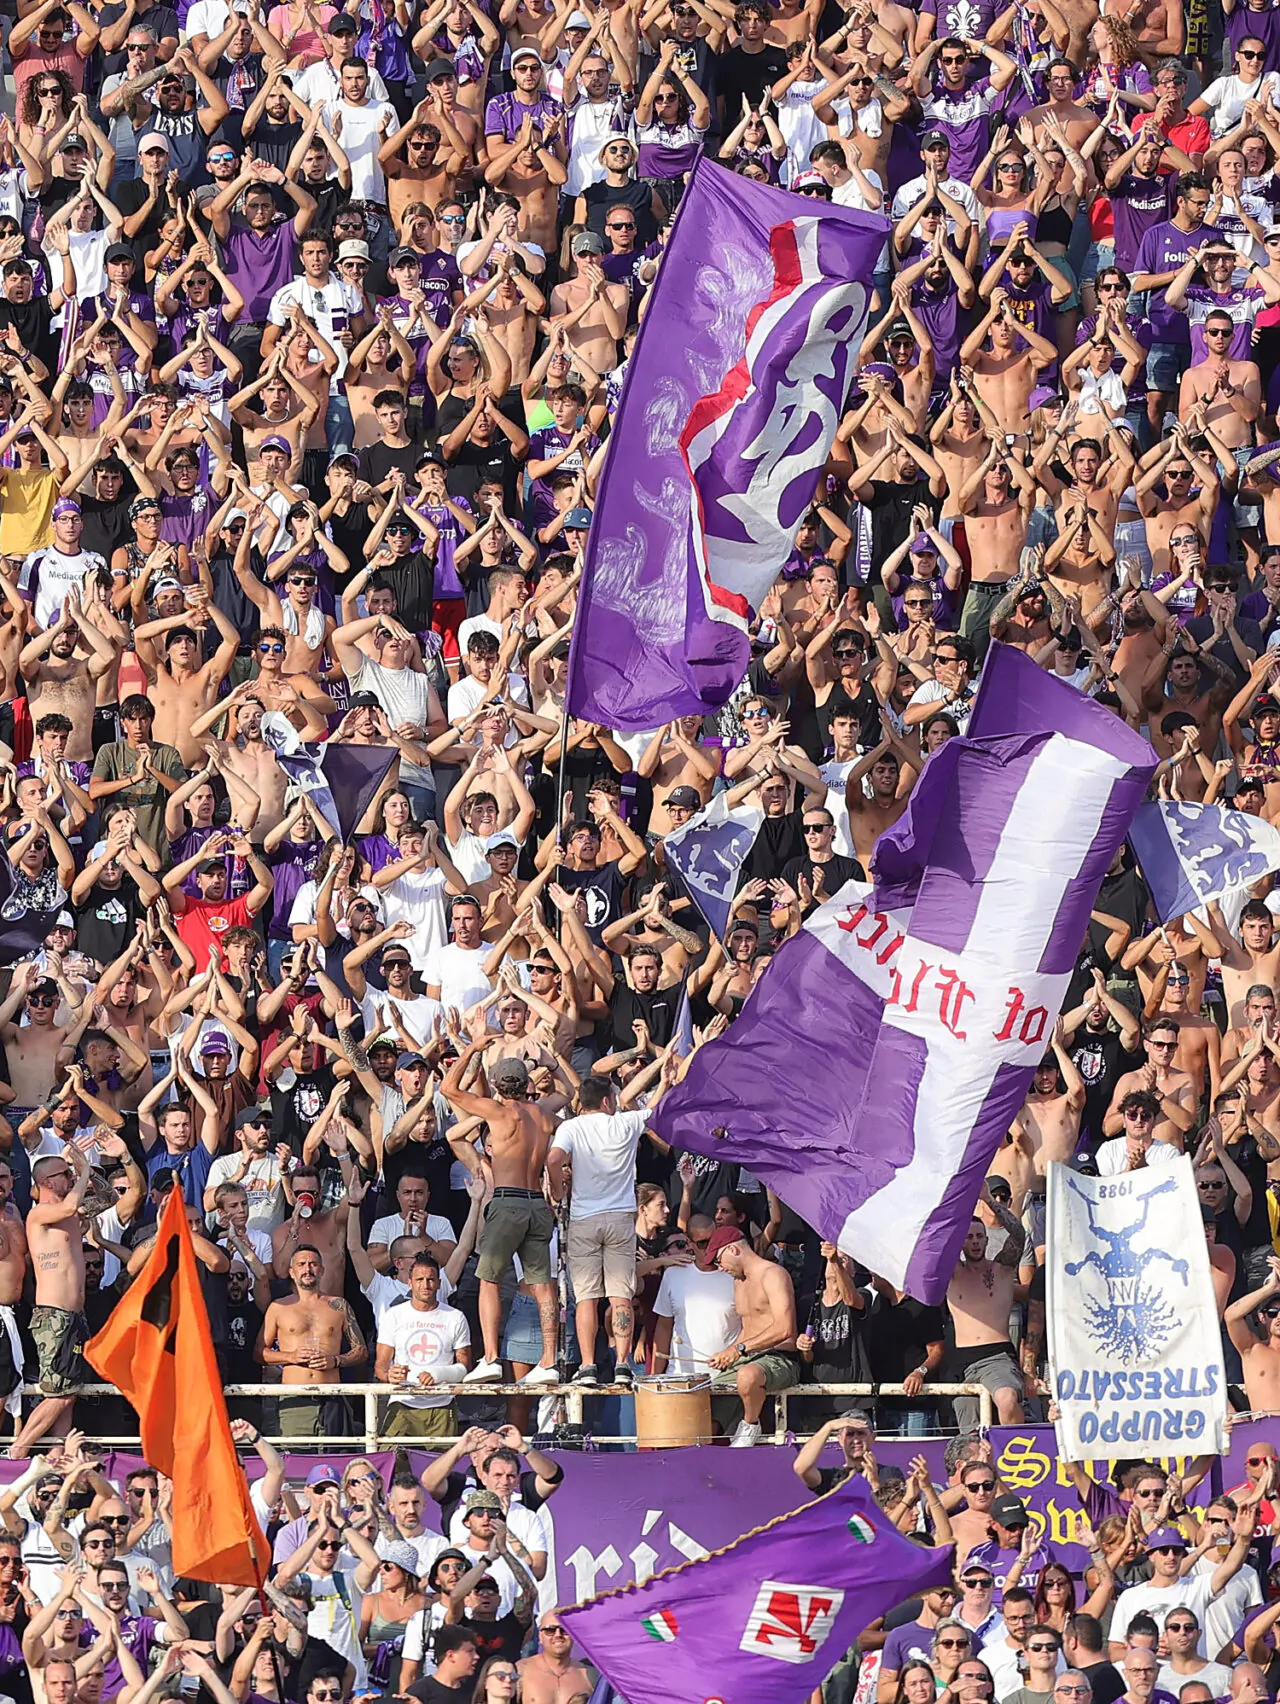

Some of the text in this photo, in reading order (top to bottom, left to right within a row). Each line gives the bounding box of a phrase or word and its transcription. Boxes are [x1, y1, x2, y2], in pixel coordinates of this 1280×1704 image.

[48, 569, 83, 582] Mediaco
[1098, 1180, 1133, 1199] 1988
[1058, 1364, 1220, 1402] STRESSATO
[1078, 1407, 1206, 1444] GRUPPO
